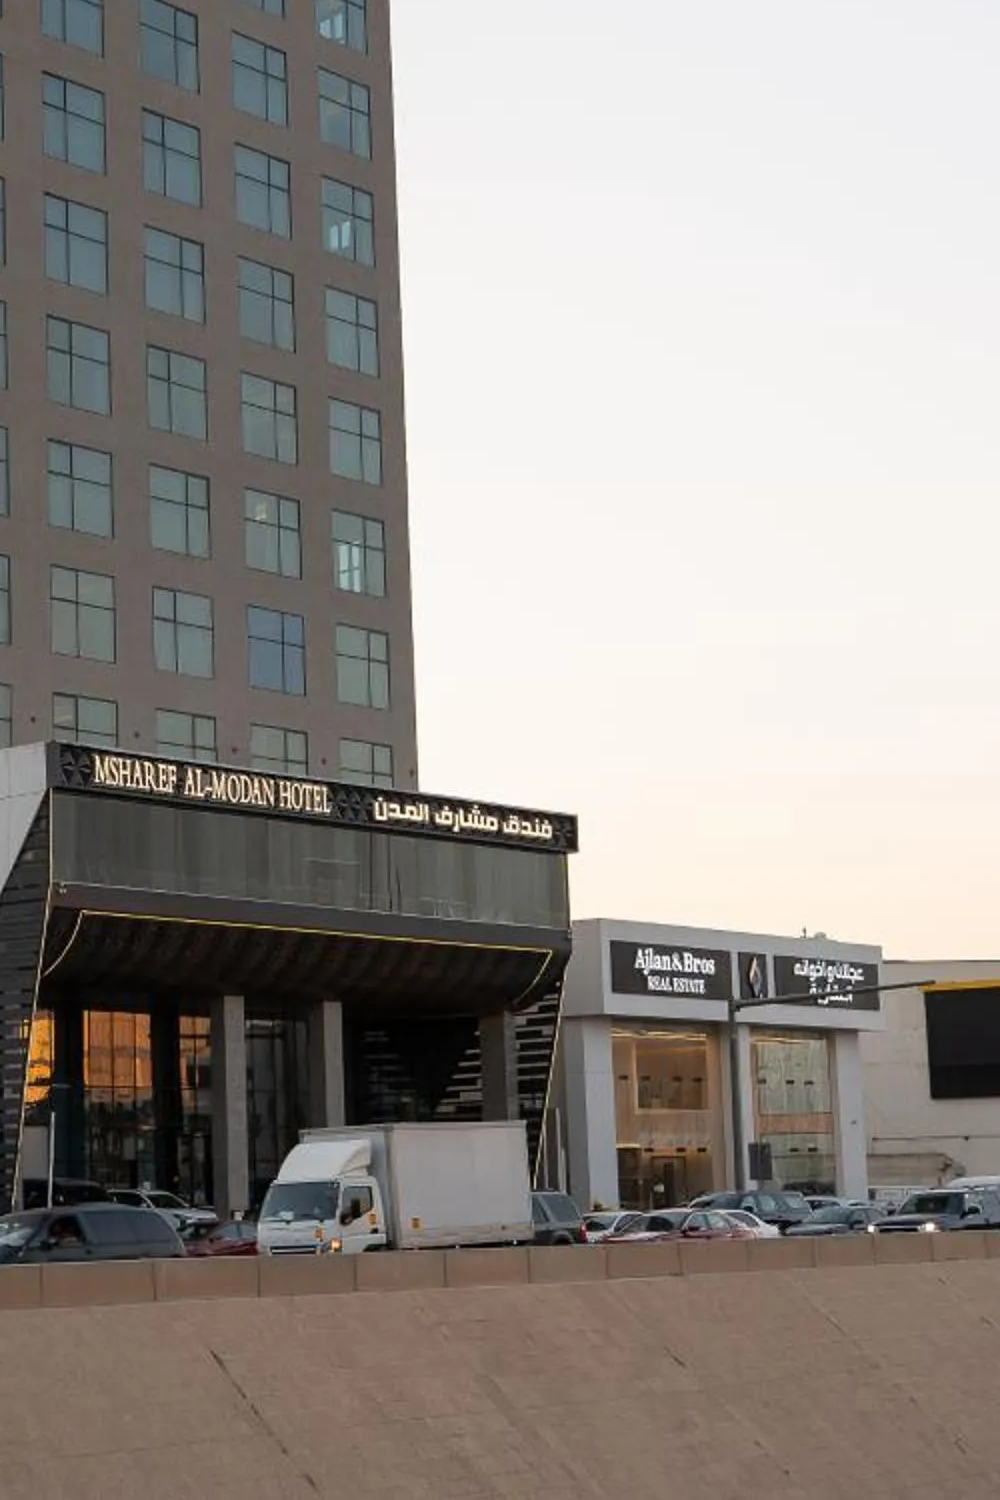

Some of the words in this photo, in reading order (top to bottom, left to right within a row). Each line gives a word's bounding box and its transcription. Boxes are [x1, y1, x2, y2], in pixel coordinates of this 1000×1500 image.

[93, 755, 178, 793] MSHAREF
[184, 766, 275, 808] AL-MODAN
[279, 780, 331, 813] HOTEL
[373, 796, 430, 822] المدن
[435, 804, 499, 832] مشارف
[502, 814, 553, 839] فندق
[647, 975, 673, 991] REAL
[673, 977, 706, 995] ESTATE
